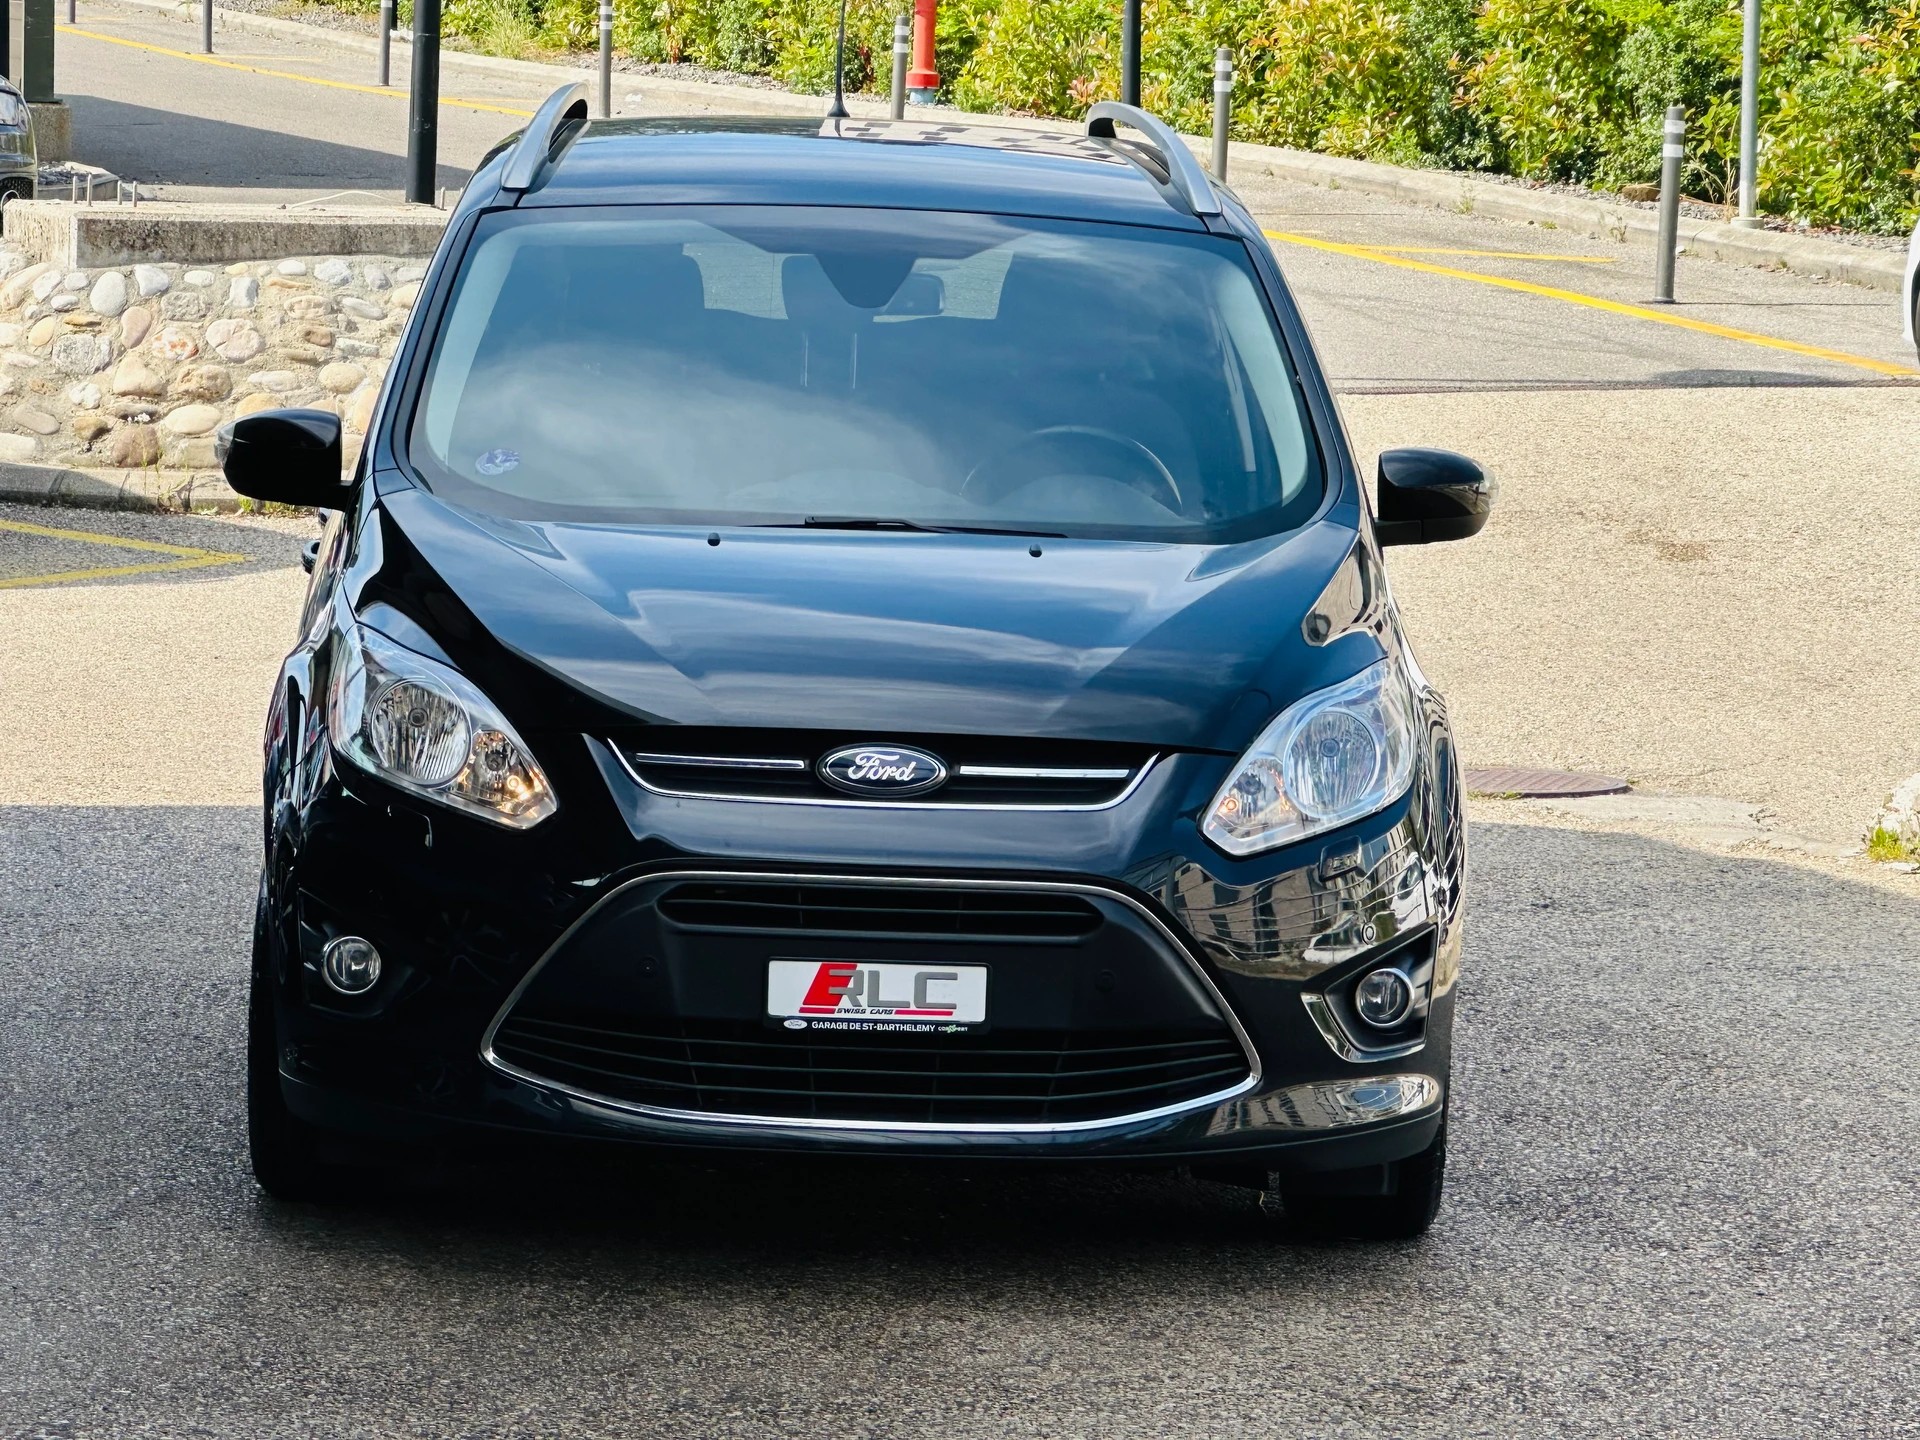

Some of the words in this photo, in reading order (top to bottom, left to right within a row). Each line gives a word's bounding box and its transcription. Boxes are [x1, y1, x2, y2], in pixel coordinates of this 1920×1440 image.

[848, 753, 917, 781] Ford
[803, 963, 958, 1010] ERLC
[811, 1021, 848, 1030] GARAGE
[849, 1022, 861, 1031] DE
[862, 1022, 936, 1032] ST-BARTHELEMY
